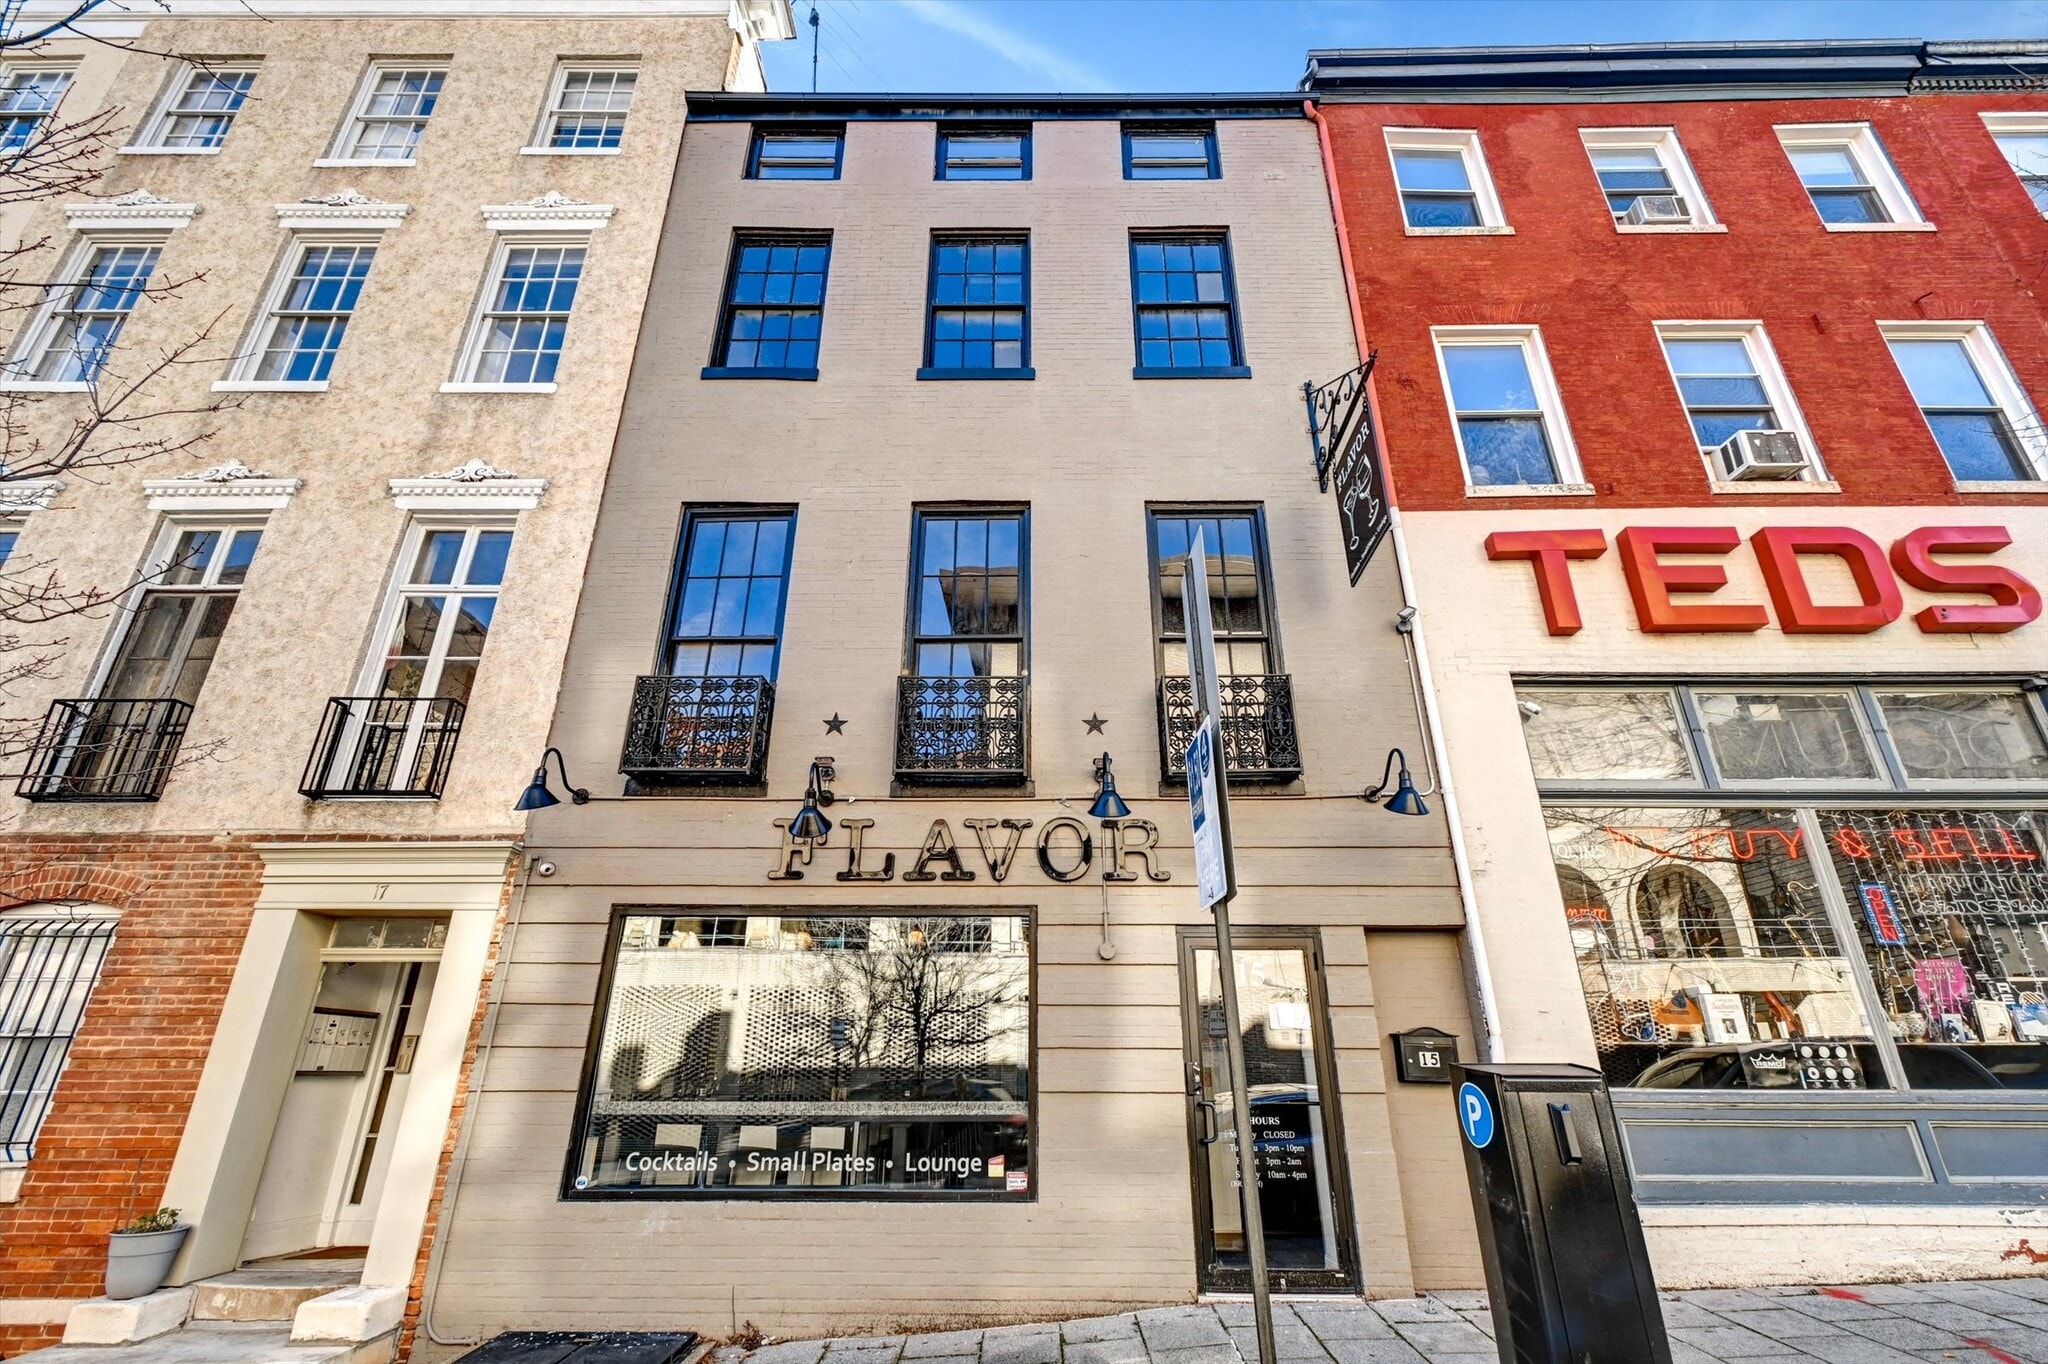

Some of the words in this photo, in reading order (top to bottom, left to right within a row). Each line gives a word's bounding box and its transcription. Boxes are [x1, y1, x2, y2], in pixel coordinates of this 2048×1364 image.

[1336, 421, 1370, 495] FLAVOR
[1485, 526, 2043, 637] TEDS
[767, 817, 1172, 882] FLAVOR
[1892, 826, 2039, 860] SELL
[373, 884, 389, 900] 17
[1866, 886, 1900, 942] OPEN
[1421, 1053, 1438, 1066] 15
[1249, 1116, 1280, 1125] HOURS
[1464, 1094, 1483, 1137] P
[1263, 1130, 1296, 1139] CLOSED
[1264, 1143, 1280, 1154] 3pm
[1286, 1143, 1305, 1154] 10pm
[625, 1151, 718, 1173] Cocktails
[746, 1151, 806, 1173] Small
[812, 1152, 876, 1173] Plates
[905, 1152, 983, 1179] Lounge
[1266, 1156, 1282, 1167] 3pm
[1286, 1156, 1302, 1166] 2am
[1268, 1170, 1286, 1179] 10am
[1291, 1170, 1308, 1181] 4pm
